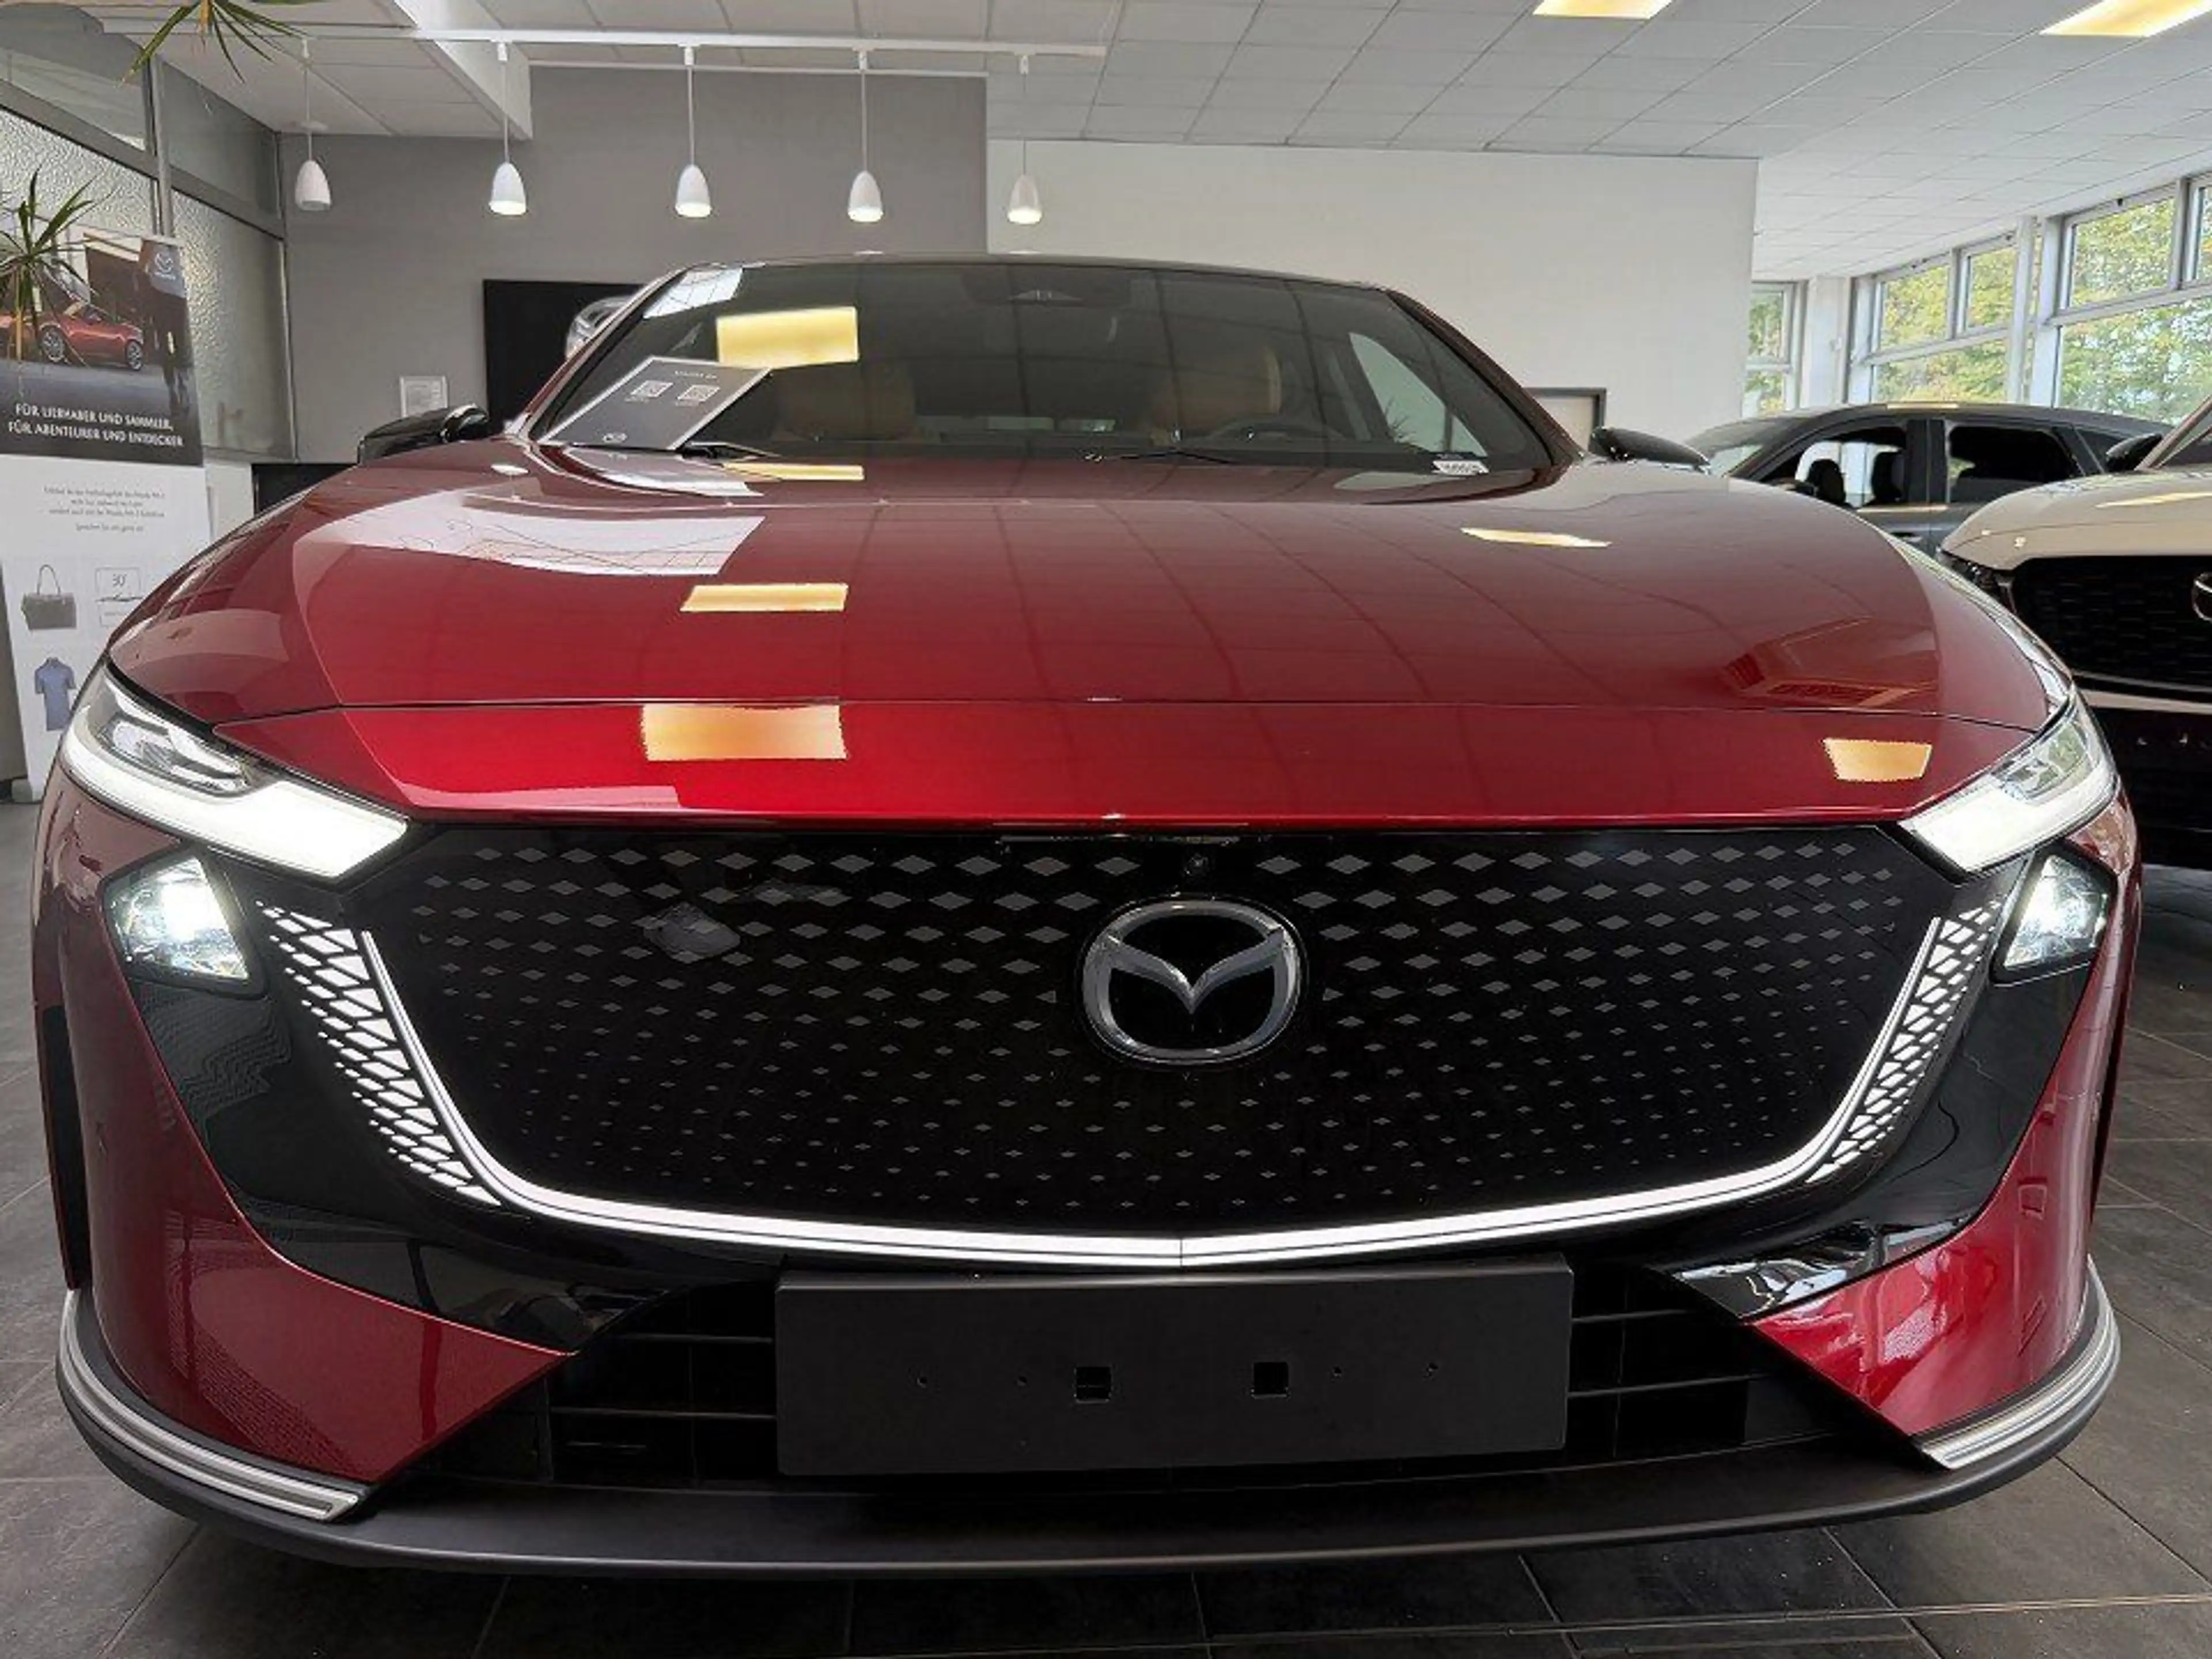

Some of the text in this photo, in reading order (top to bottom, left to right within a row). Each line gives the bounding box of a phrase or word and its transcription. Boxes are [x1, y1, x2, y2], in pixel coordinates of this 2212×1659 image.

[99, 412, 123, 425] UND
[8, 419, 32, 434] FÜR
[102, 430, 126, 444] UND
